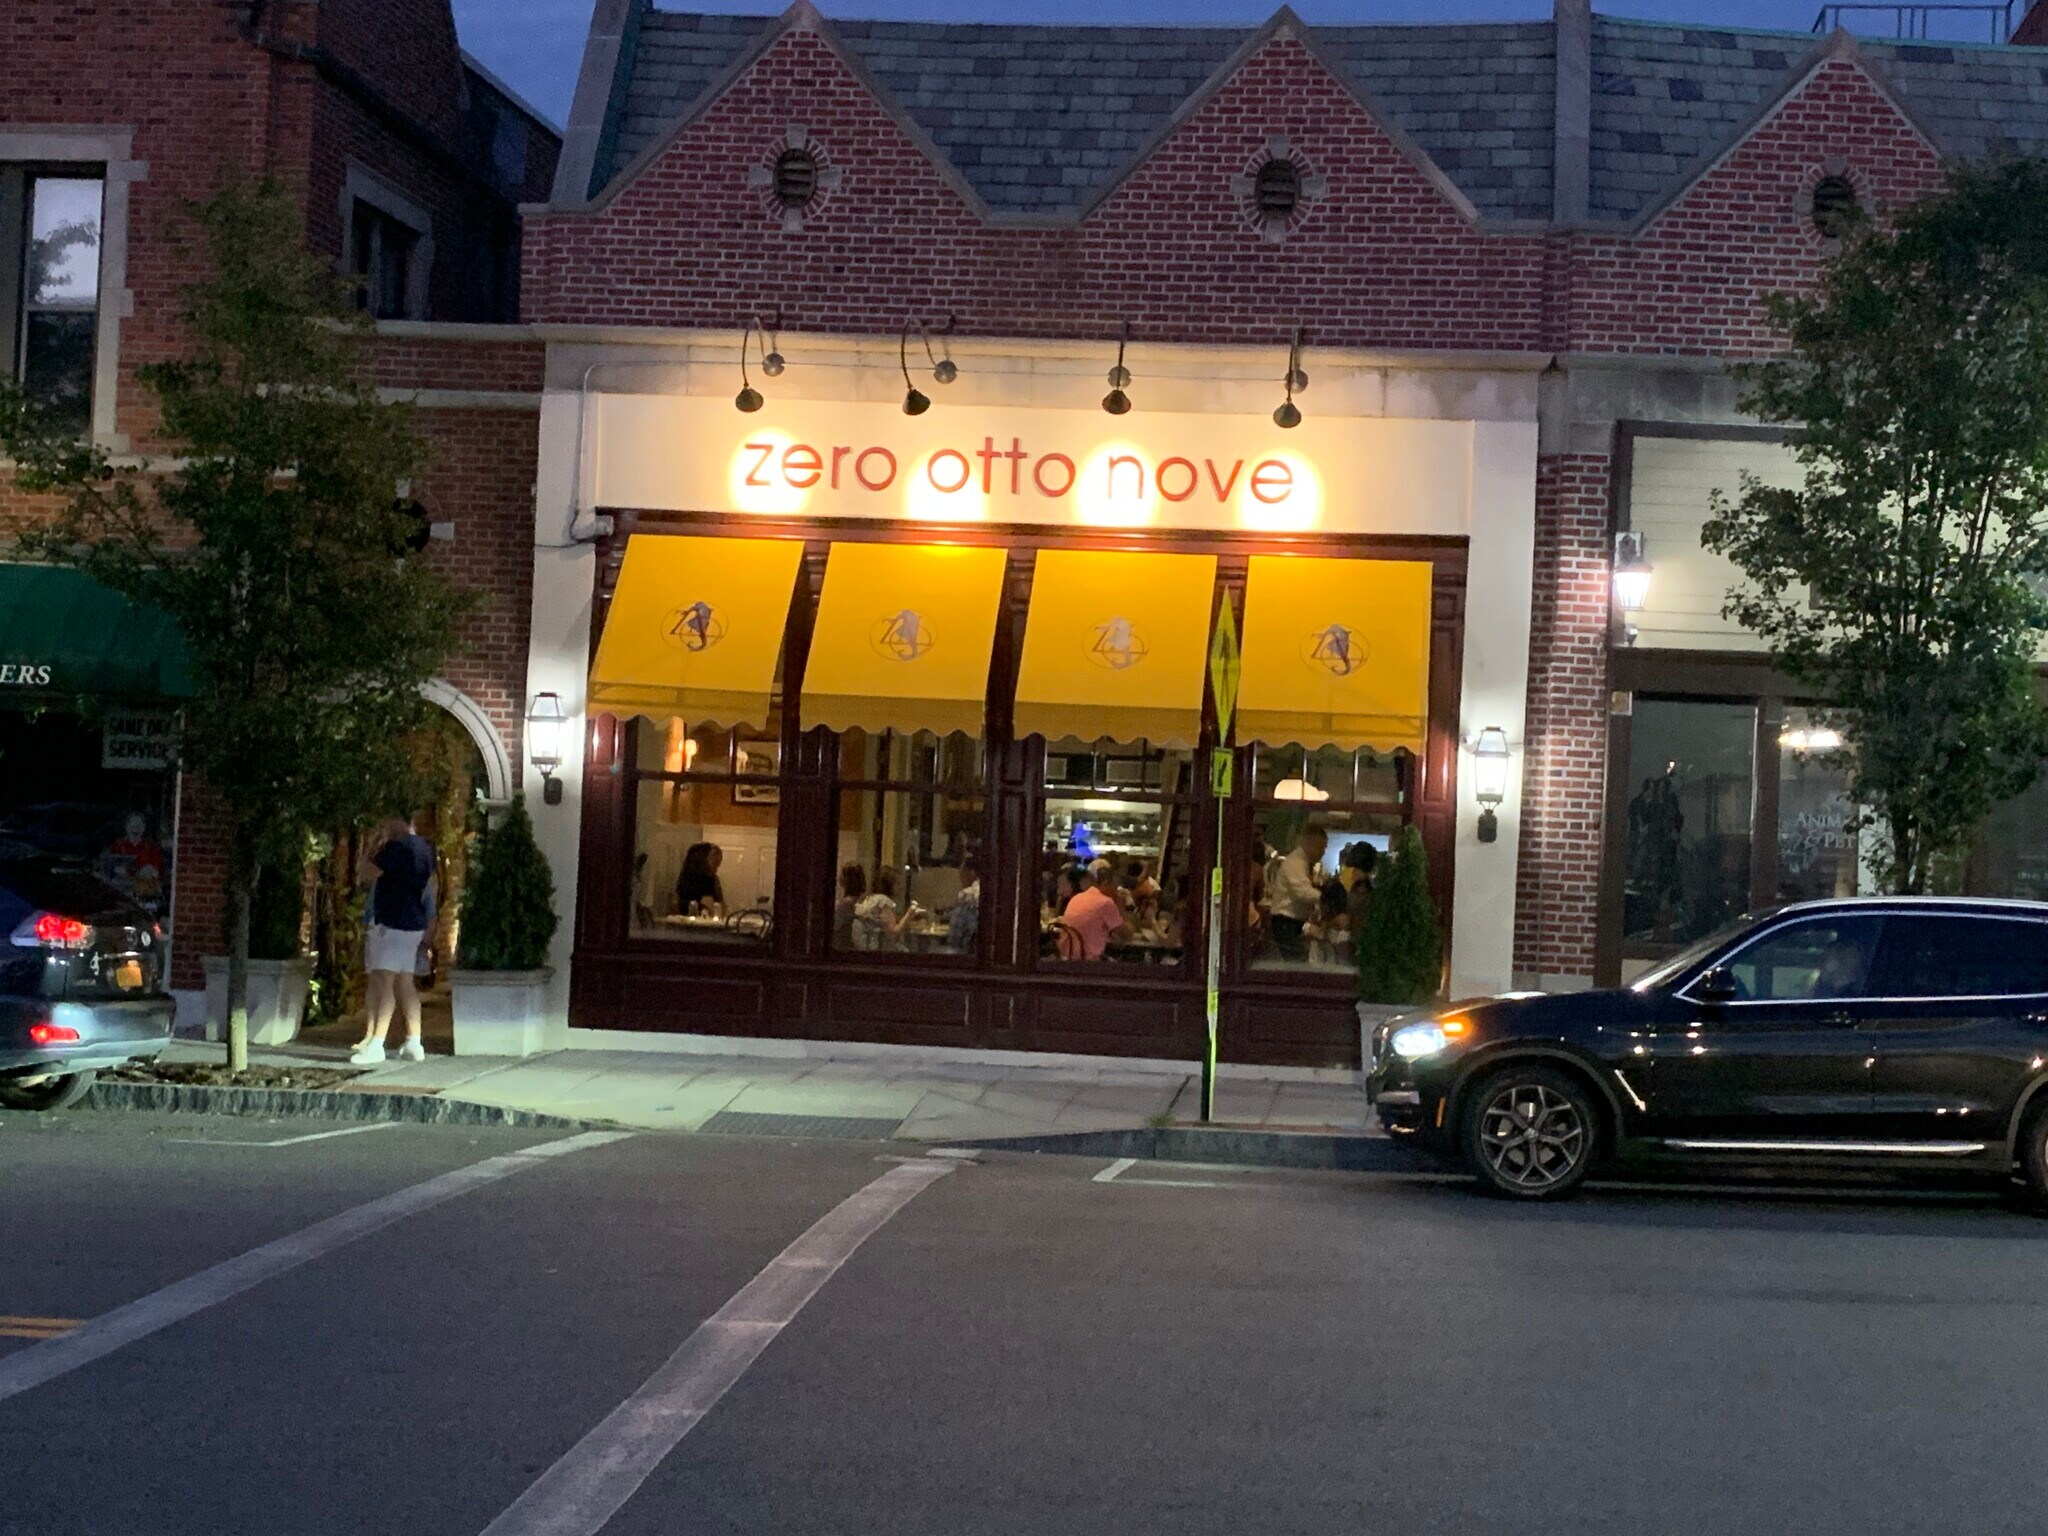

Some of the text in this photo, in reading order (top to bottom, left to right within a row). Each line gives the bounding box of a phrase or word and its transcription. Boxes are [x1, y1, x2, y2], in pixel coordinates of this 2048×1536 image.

[744, 436, 1294, 504] zero otto nove
[0, 664, 52, 686] ERS
[1796, 811, 1852, 829] ANIM
